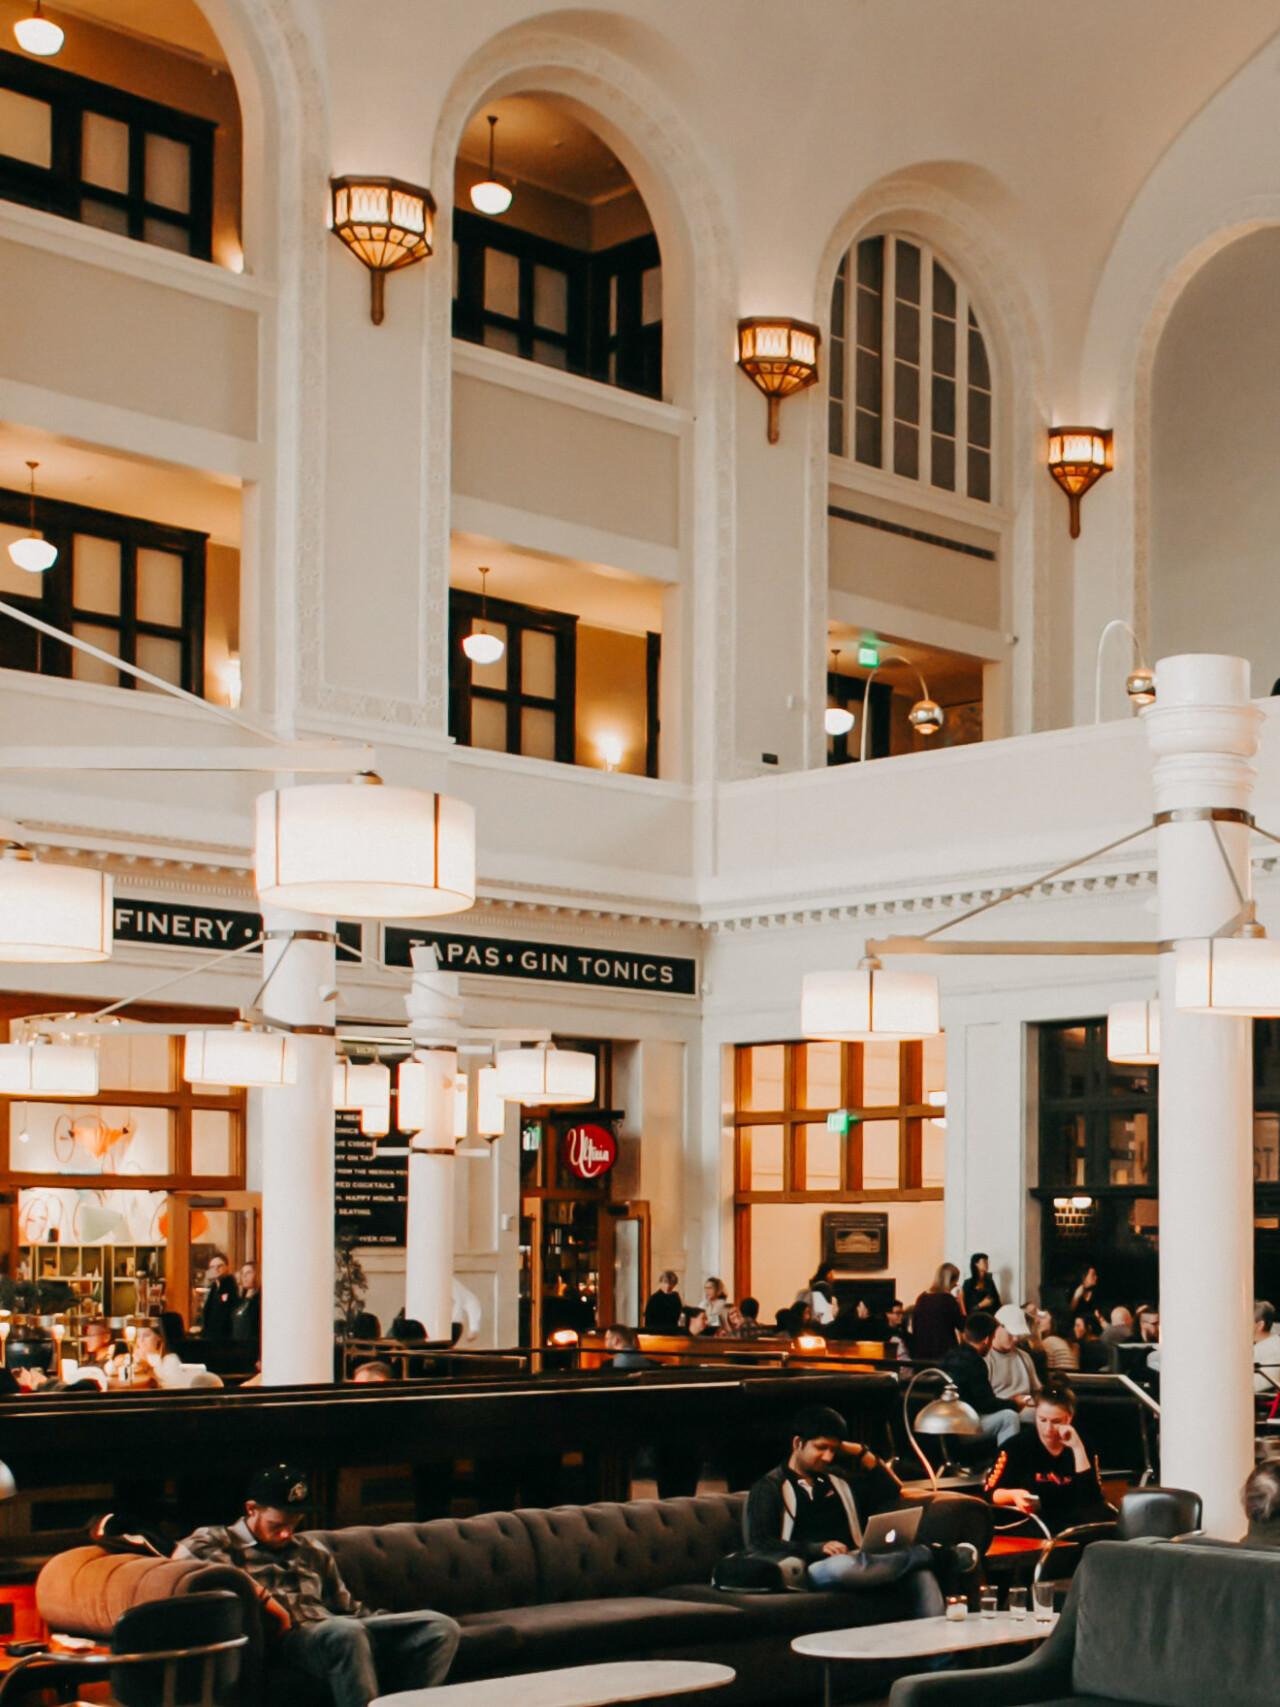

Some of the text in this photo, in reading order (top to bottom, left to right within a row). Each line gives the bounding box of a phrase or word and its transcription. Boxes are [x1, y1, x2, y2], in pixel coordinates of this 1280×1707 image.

[114, 907, 234, 942] FINERY
[520, 951, 568, 974] GIN
[578, 956, 675, 985] TONICS
